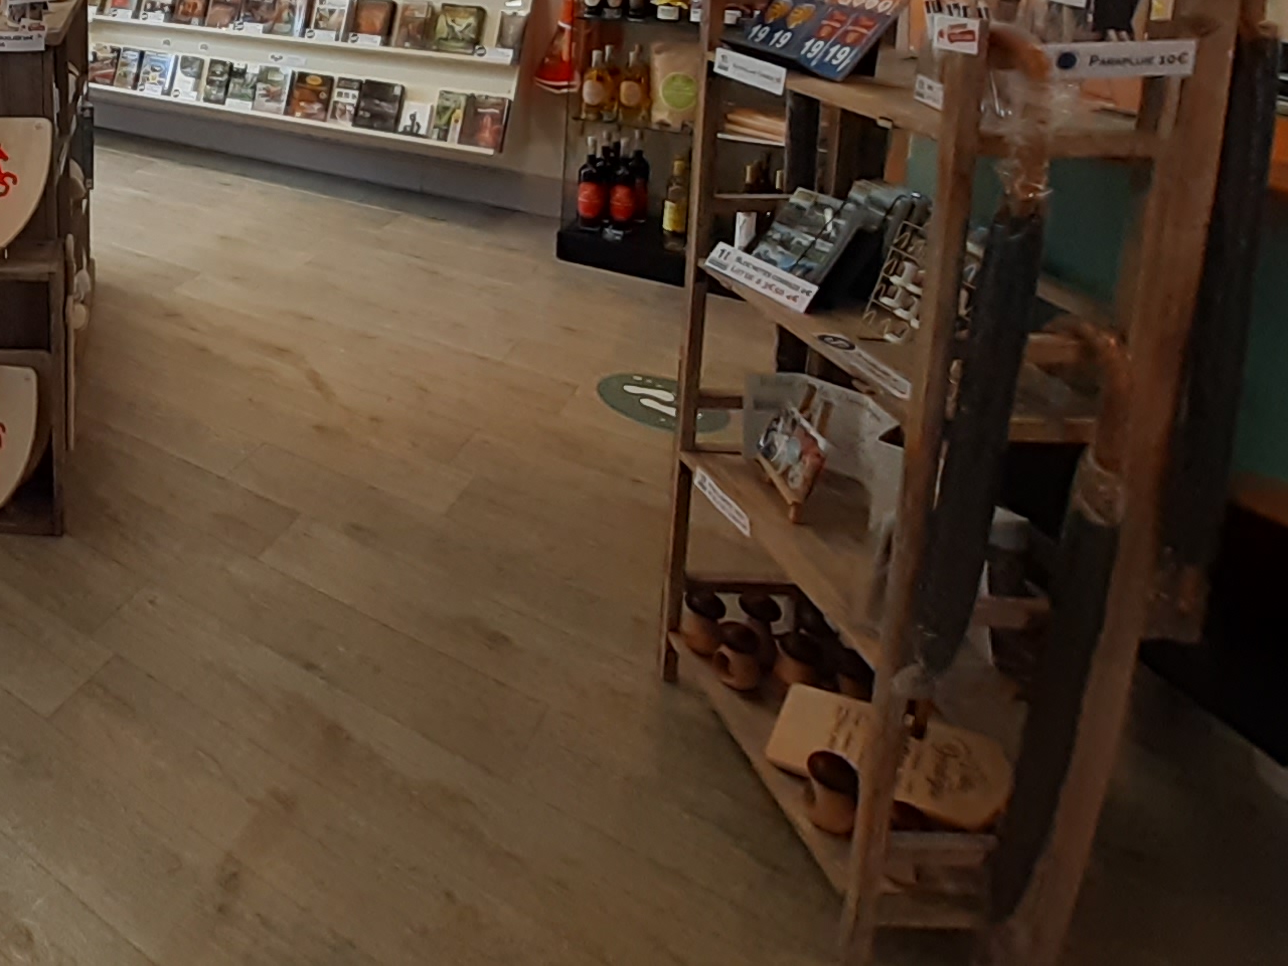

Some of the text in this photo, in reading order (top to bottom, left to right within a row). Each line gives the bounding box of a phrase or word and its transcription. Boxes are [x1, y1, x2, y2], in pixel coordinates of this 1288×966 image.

[749, 24, 770, 42] 19
[770, 31, 791, 48] 19
[801, 39, 824, 58] 19
[825, 46, 849, 65] 19
